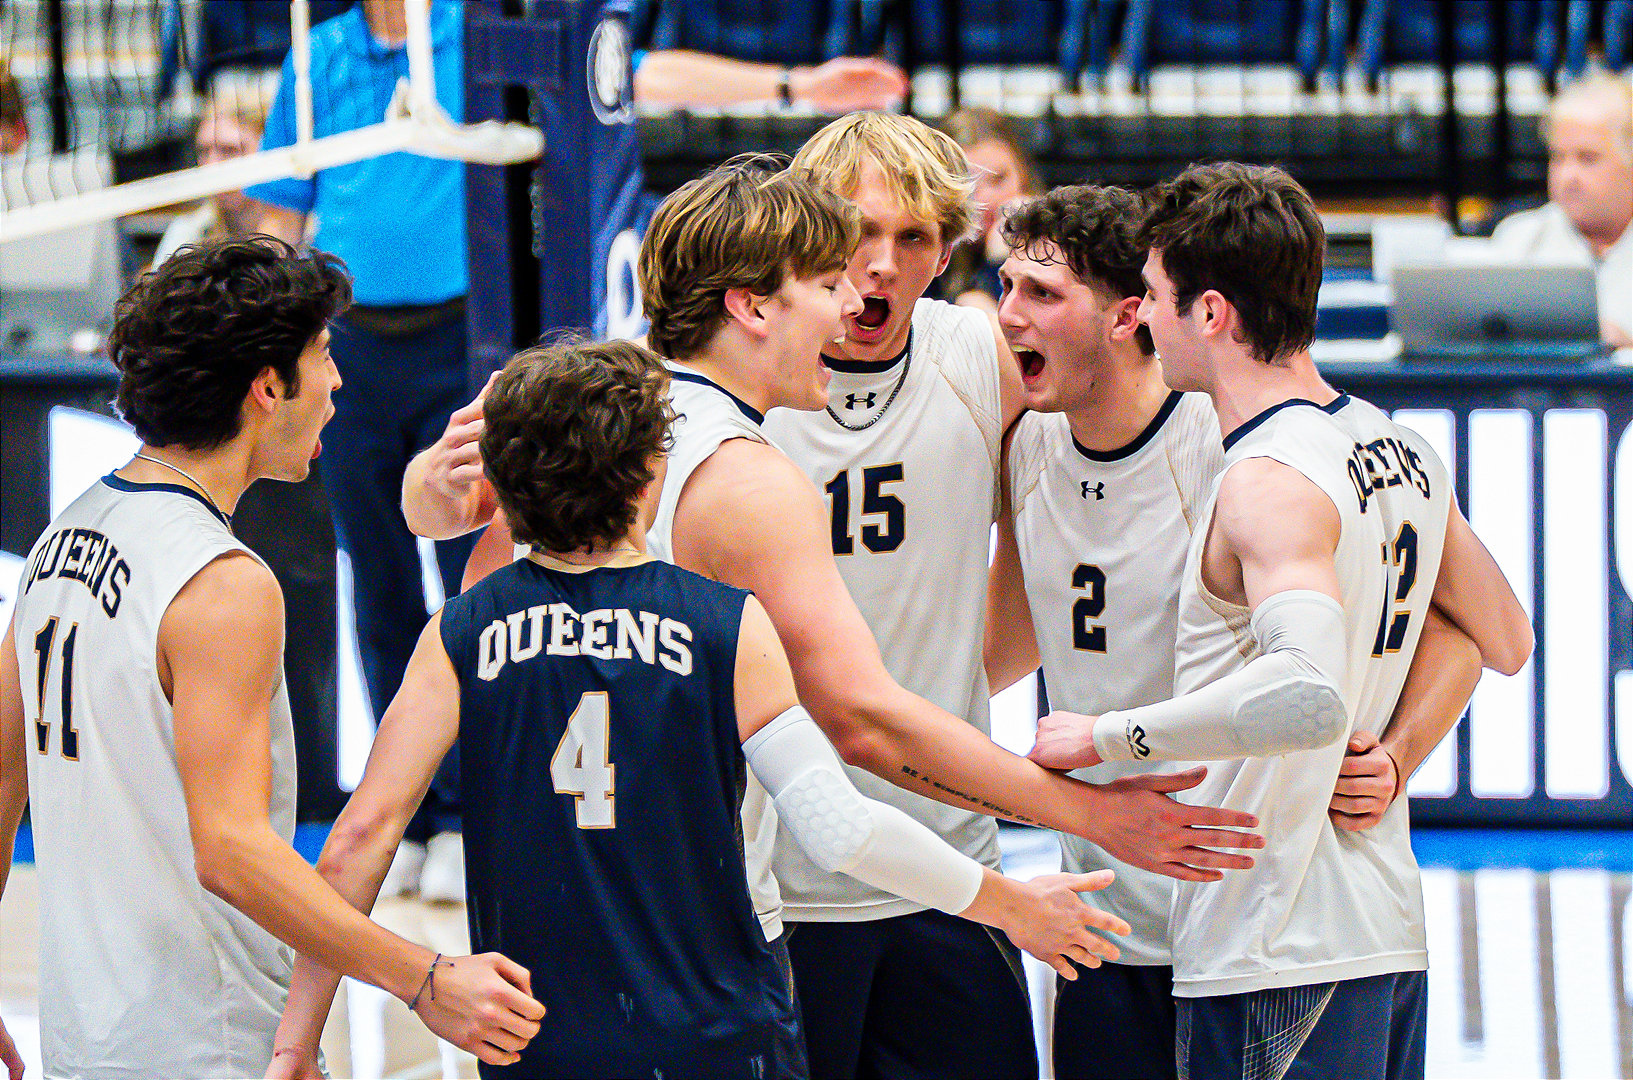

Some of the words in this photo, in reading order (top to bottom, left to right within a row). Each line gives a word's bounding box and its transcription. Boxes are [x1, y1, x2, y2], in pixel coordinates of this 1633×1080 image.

[824, 461, 906, 556] 15
[477, 602, 693, 682] QUEENS
[1071, 562, 1107, 654] 2
[34, 614, 80, 762] 11
[550, 691, 616, 829] 4
